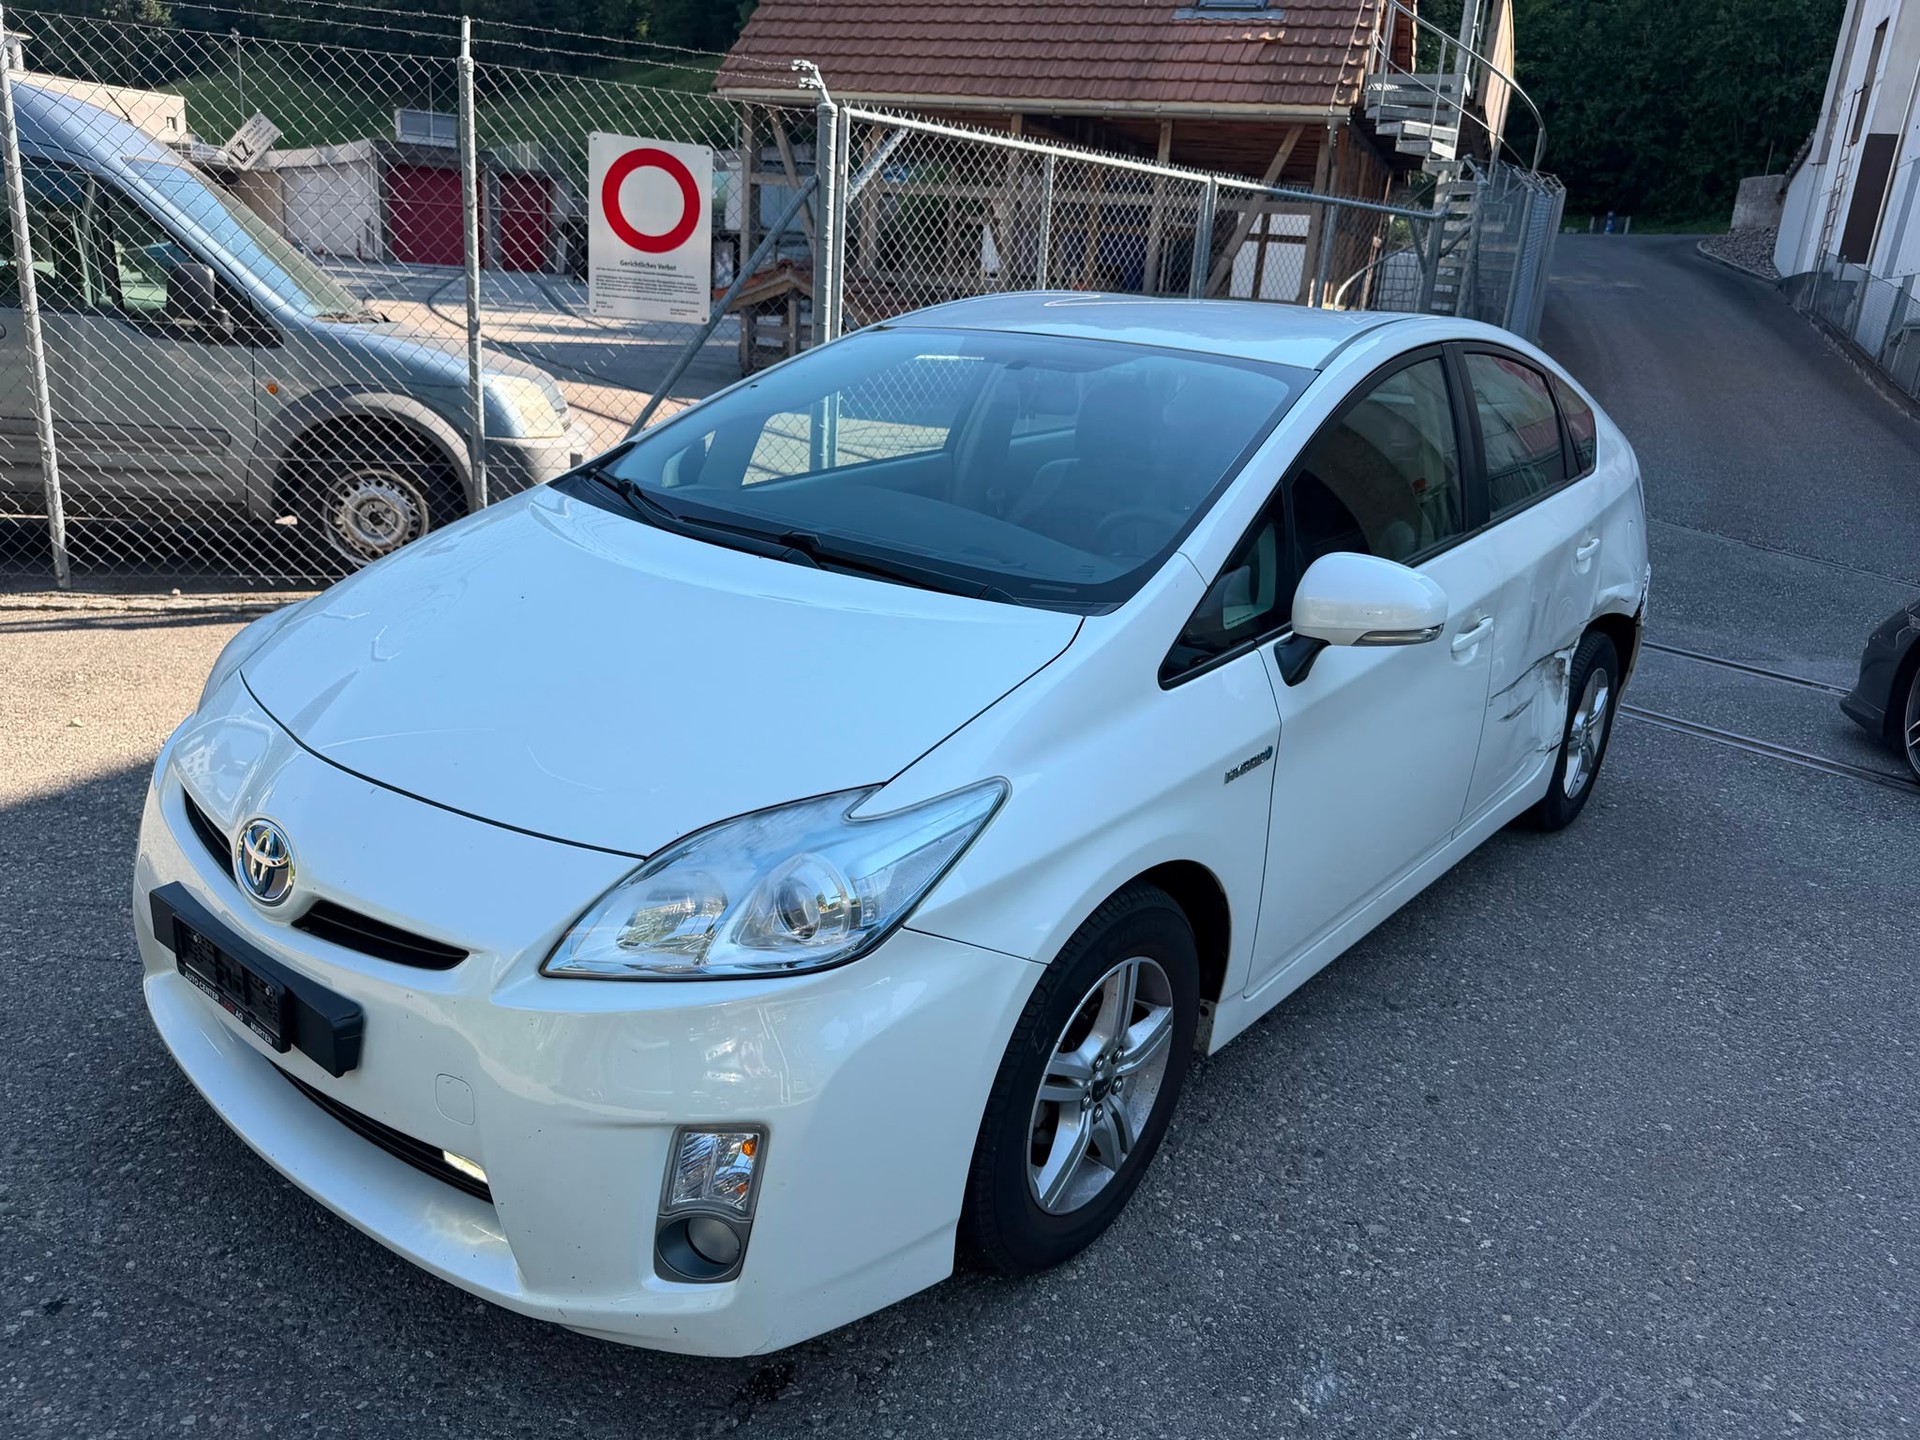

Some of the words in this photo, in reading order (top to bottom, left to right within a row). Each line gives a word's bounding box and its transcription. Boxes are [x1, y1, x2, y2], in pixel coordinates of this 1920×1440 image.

[229, 139, 255, 164] LZ
[620, 260, 656, 269] Gerichtliches
[657, 263, 677, 271] Verbot
[185, 971, 199, 986] AUTO
[200, 981, 219, 1002] CENTER
[235, 1010, 243, 1020] AG
[250, 1021, 273, 1044] MURTEN
